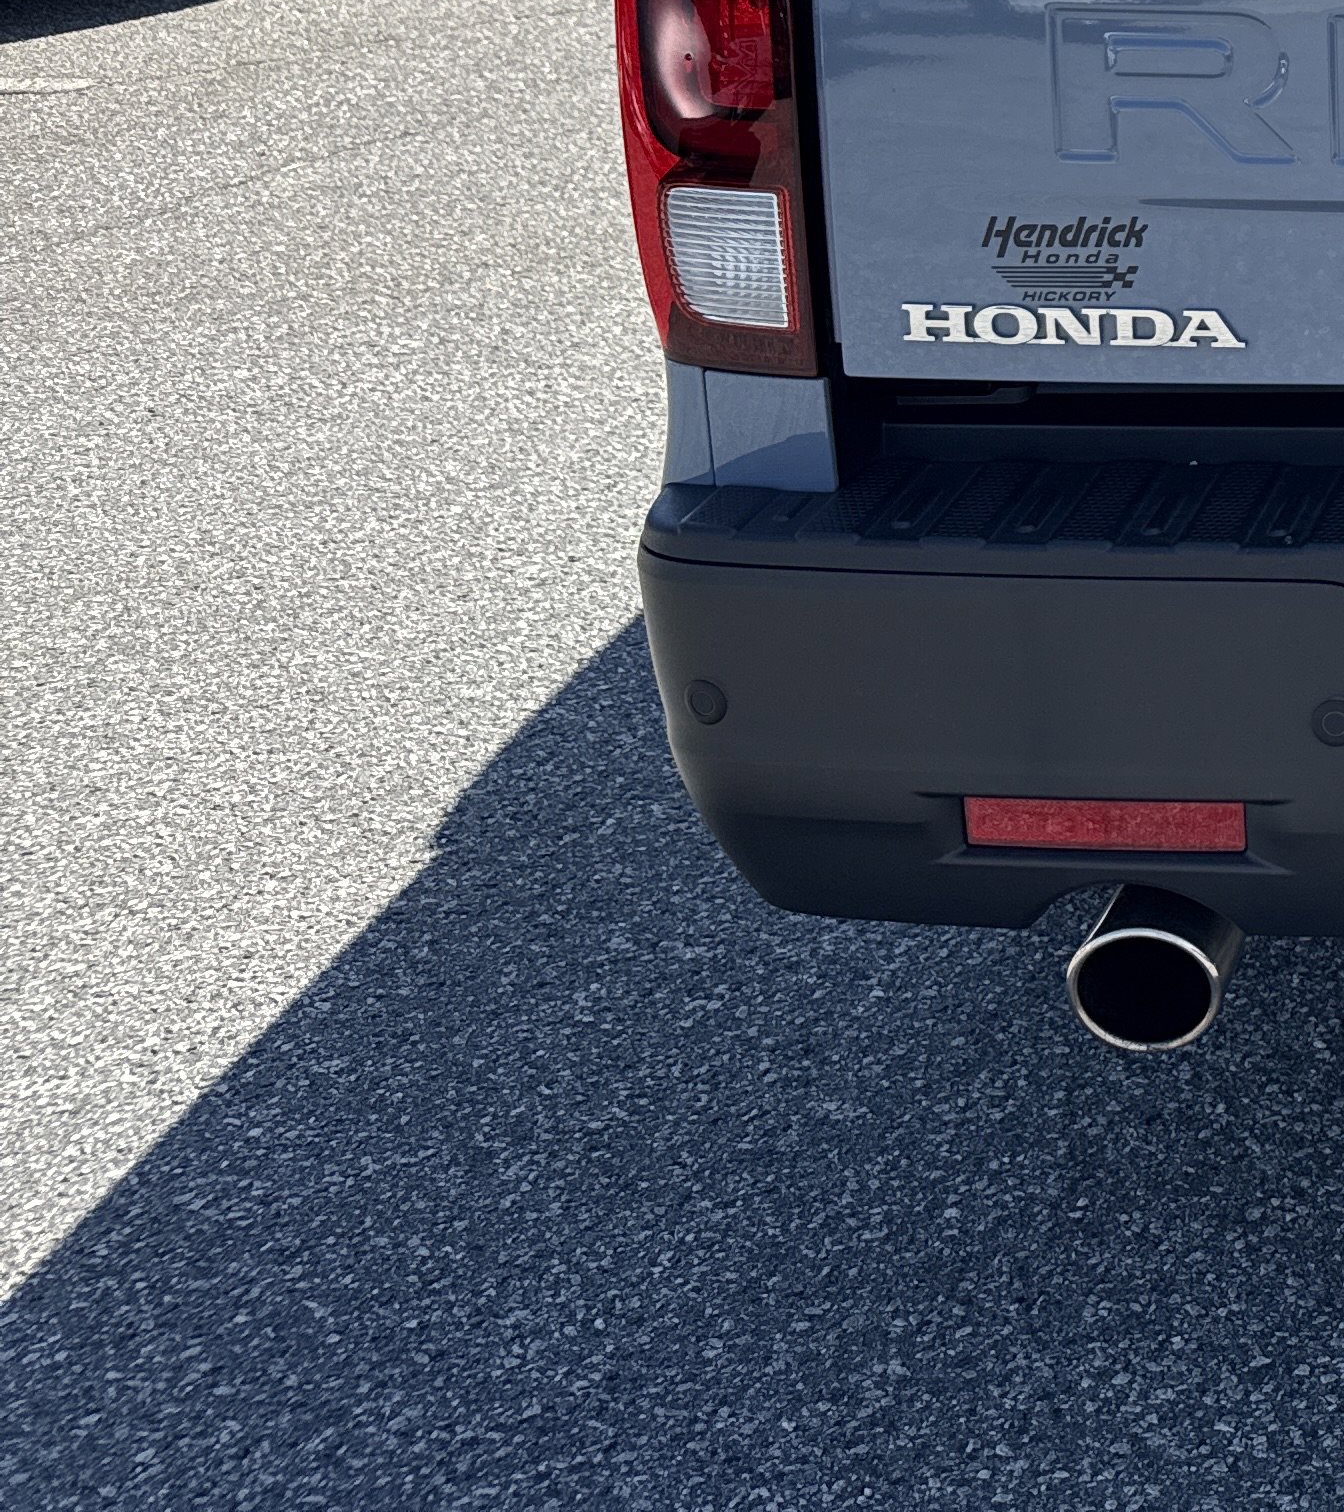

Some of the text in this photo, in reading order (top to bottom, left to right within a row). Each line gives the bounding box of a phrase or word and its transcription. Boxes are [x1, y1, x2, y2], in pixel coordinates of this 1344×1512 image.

[981, 215, 1148, 258] Hendrick
[1021, 250, 1120, 265] Honda
[1022, 291, 1117, 302] HICKORY
[901, 303, 1247, 348] HONDA
